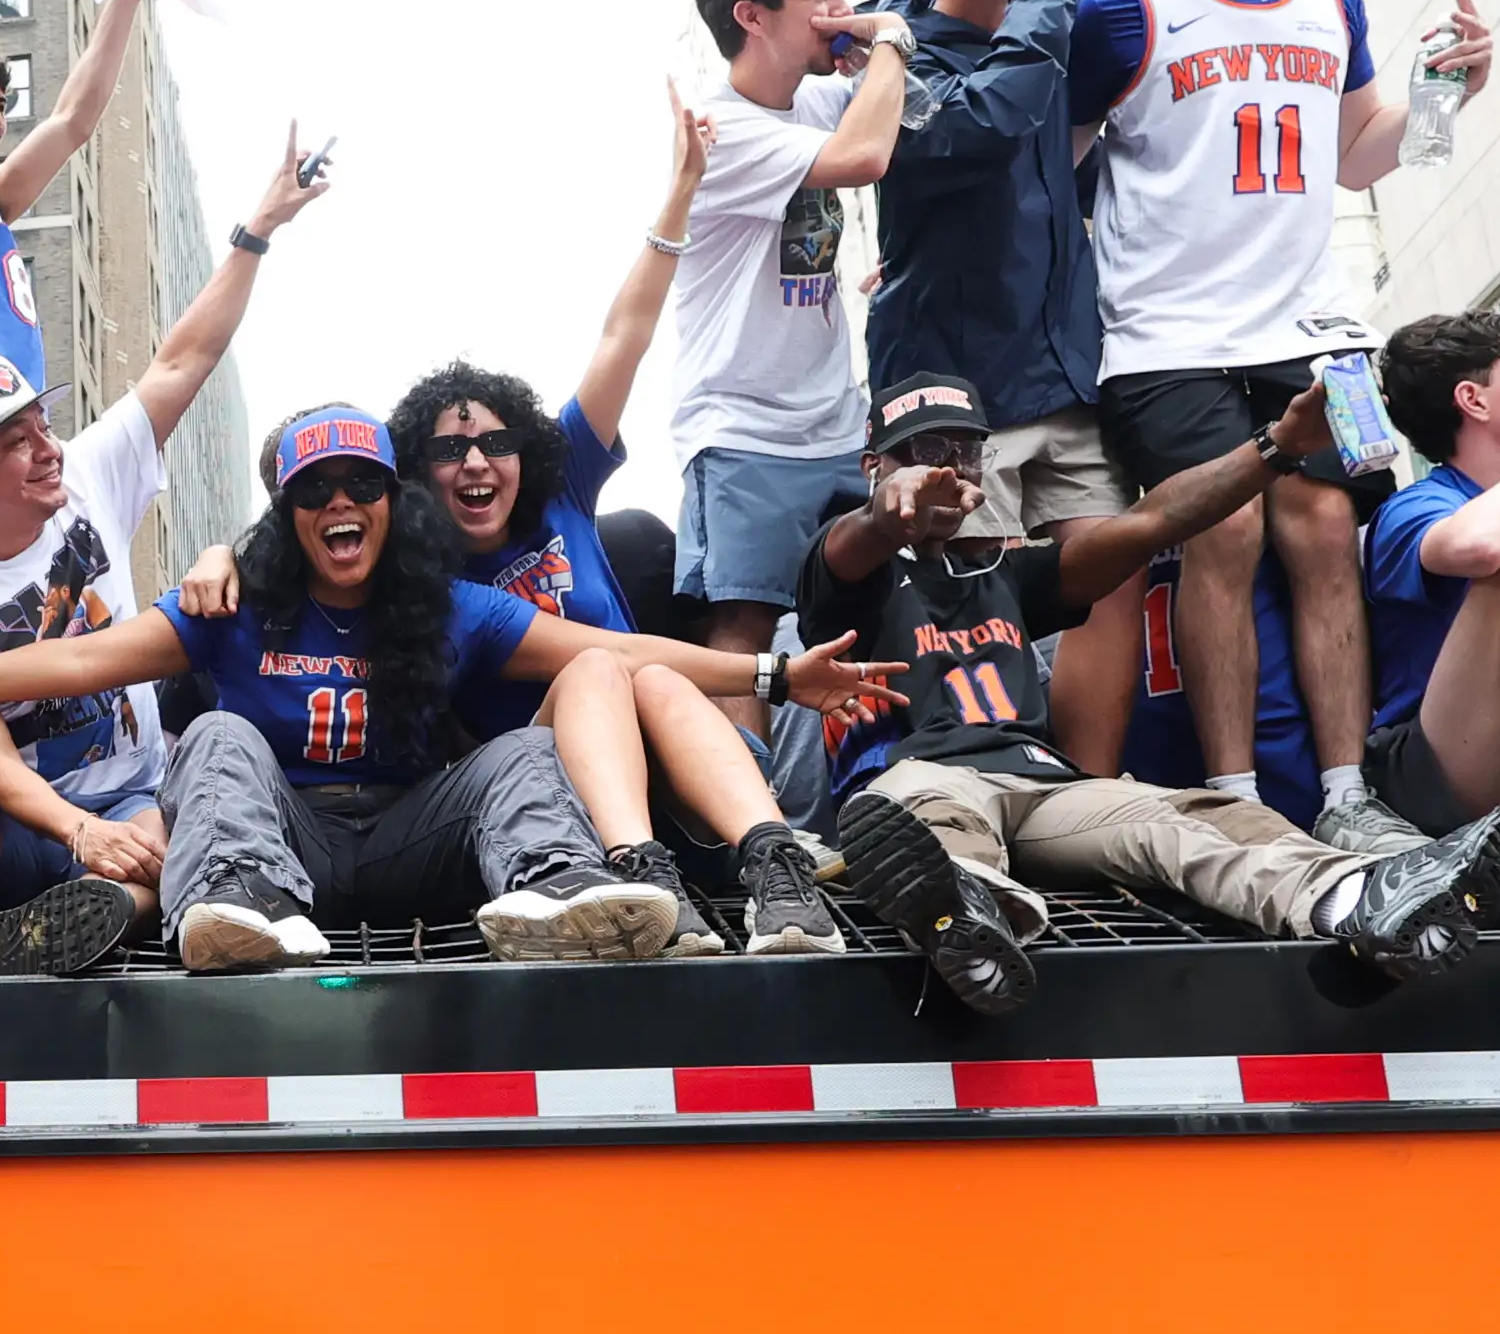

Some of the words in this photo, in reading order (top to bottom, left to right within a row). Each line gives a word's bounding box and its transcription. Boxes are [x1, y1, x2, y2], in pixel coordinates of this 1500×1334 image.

[1167, 45, 1253, 103] NEW
[1256, 44, 1341, 97] YORK
[1233, 103, 1306, 194] 11
[2, 249, 36, 327] 8
[780, 278, 822, 307] THE
[882, 392, 923, 426] NEW
[922, 386, 973, 411] YORK
[294, 428, 331, 460] NEW
[333, 419, 378, 453] YORK
[496, 566, 516, 589] NEW
[513, 552, 538, 576] YORK
[951, 618, 1022, 654] YORK
[259, 651, 334, 677] NEW
[944, 662, 1018, 725] 11
[303, 687, 368, 764] 11
